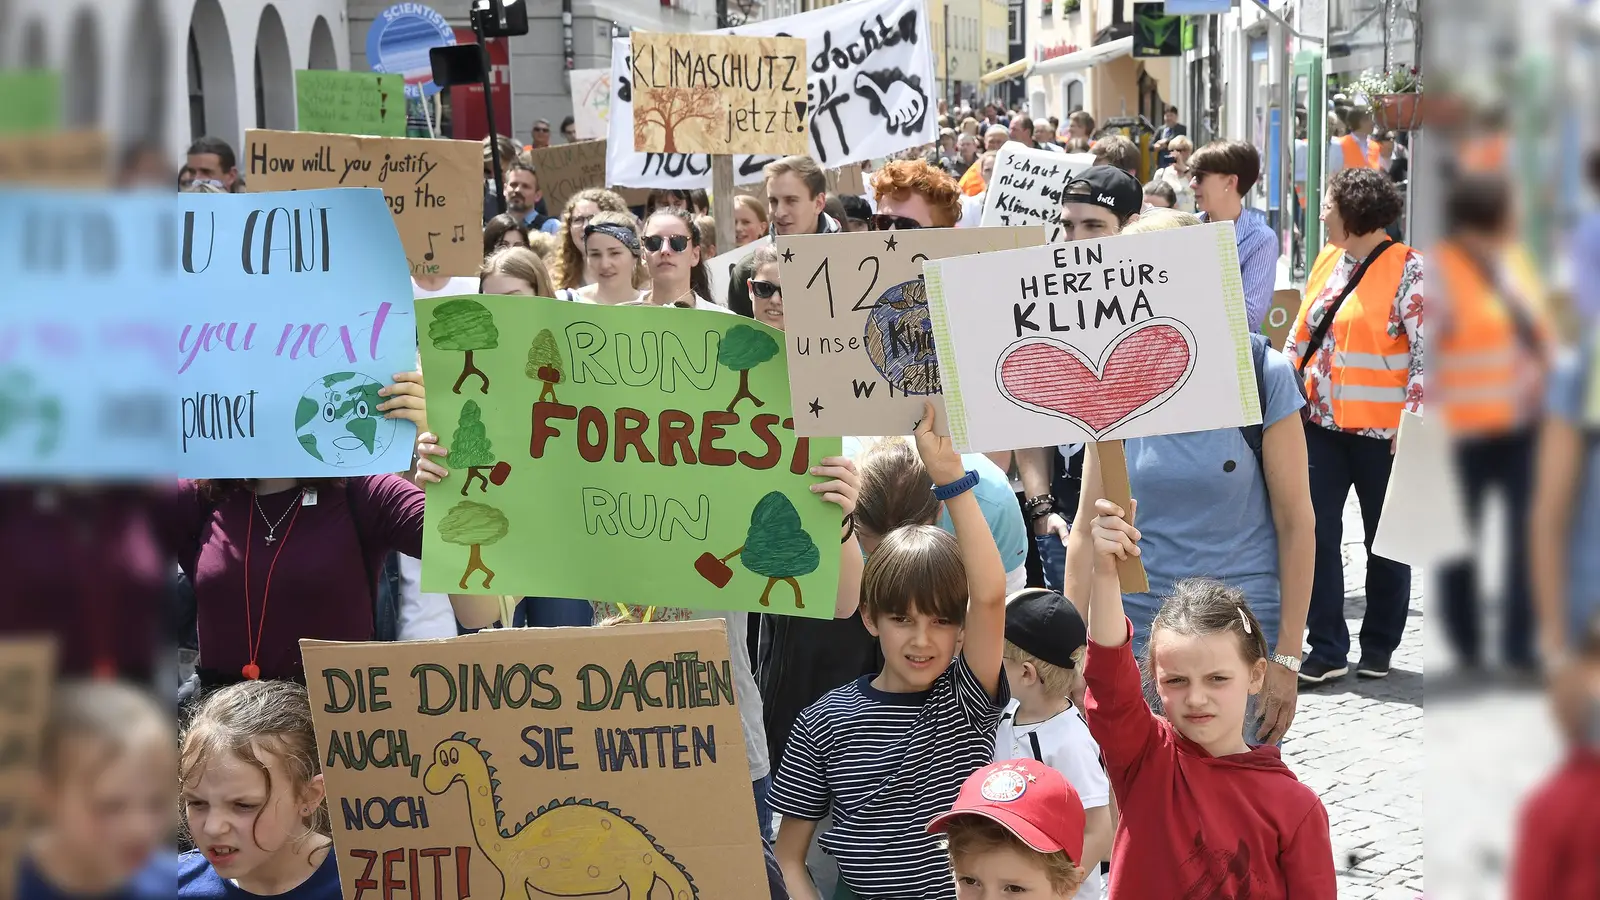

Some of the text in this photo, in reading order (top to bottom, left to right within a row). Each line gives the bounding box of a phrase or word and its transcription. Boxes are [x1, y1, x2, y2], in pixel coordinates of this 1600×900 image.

[383, 3, 453, 37] SCIENTISTS
[632, 44, 801, 94] KLIMASCHUTZ,
[725, 99, 808, 143] jetzt!
[251, 142, 437, 185] How will you justify
[414, 183, 446, 207] the
[182, 210, 214, 274] U
[1054, 243, 1103, 268] EIN
[806, 257, 835, 318] 1
[851, 256, 884, 312] 2
[1020, 272, 1092, 299] HERZ
[177, 301, 408, 375] you next
[1013, 289, 1155, 337] KLIMA
[564, 321, 721, 393] RUN
[181, 389, 258, 454] planet
[529, 401, 811, 475] FORREST
[582, 486, 709, 541] RUN
[322, 651, 735, 716] DIE DINOS DACHTEN
[326, 724, 717, 778] AUCH, SIE HÄTTEN
[340, 796, 430, 831] NOCH
[350, 846, 471, 900] ZEIT!
